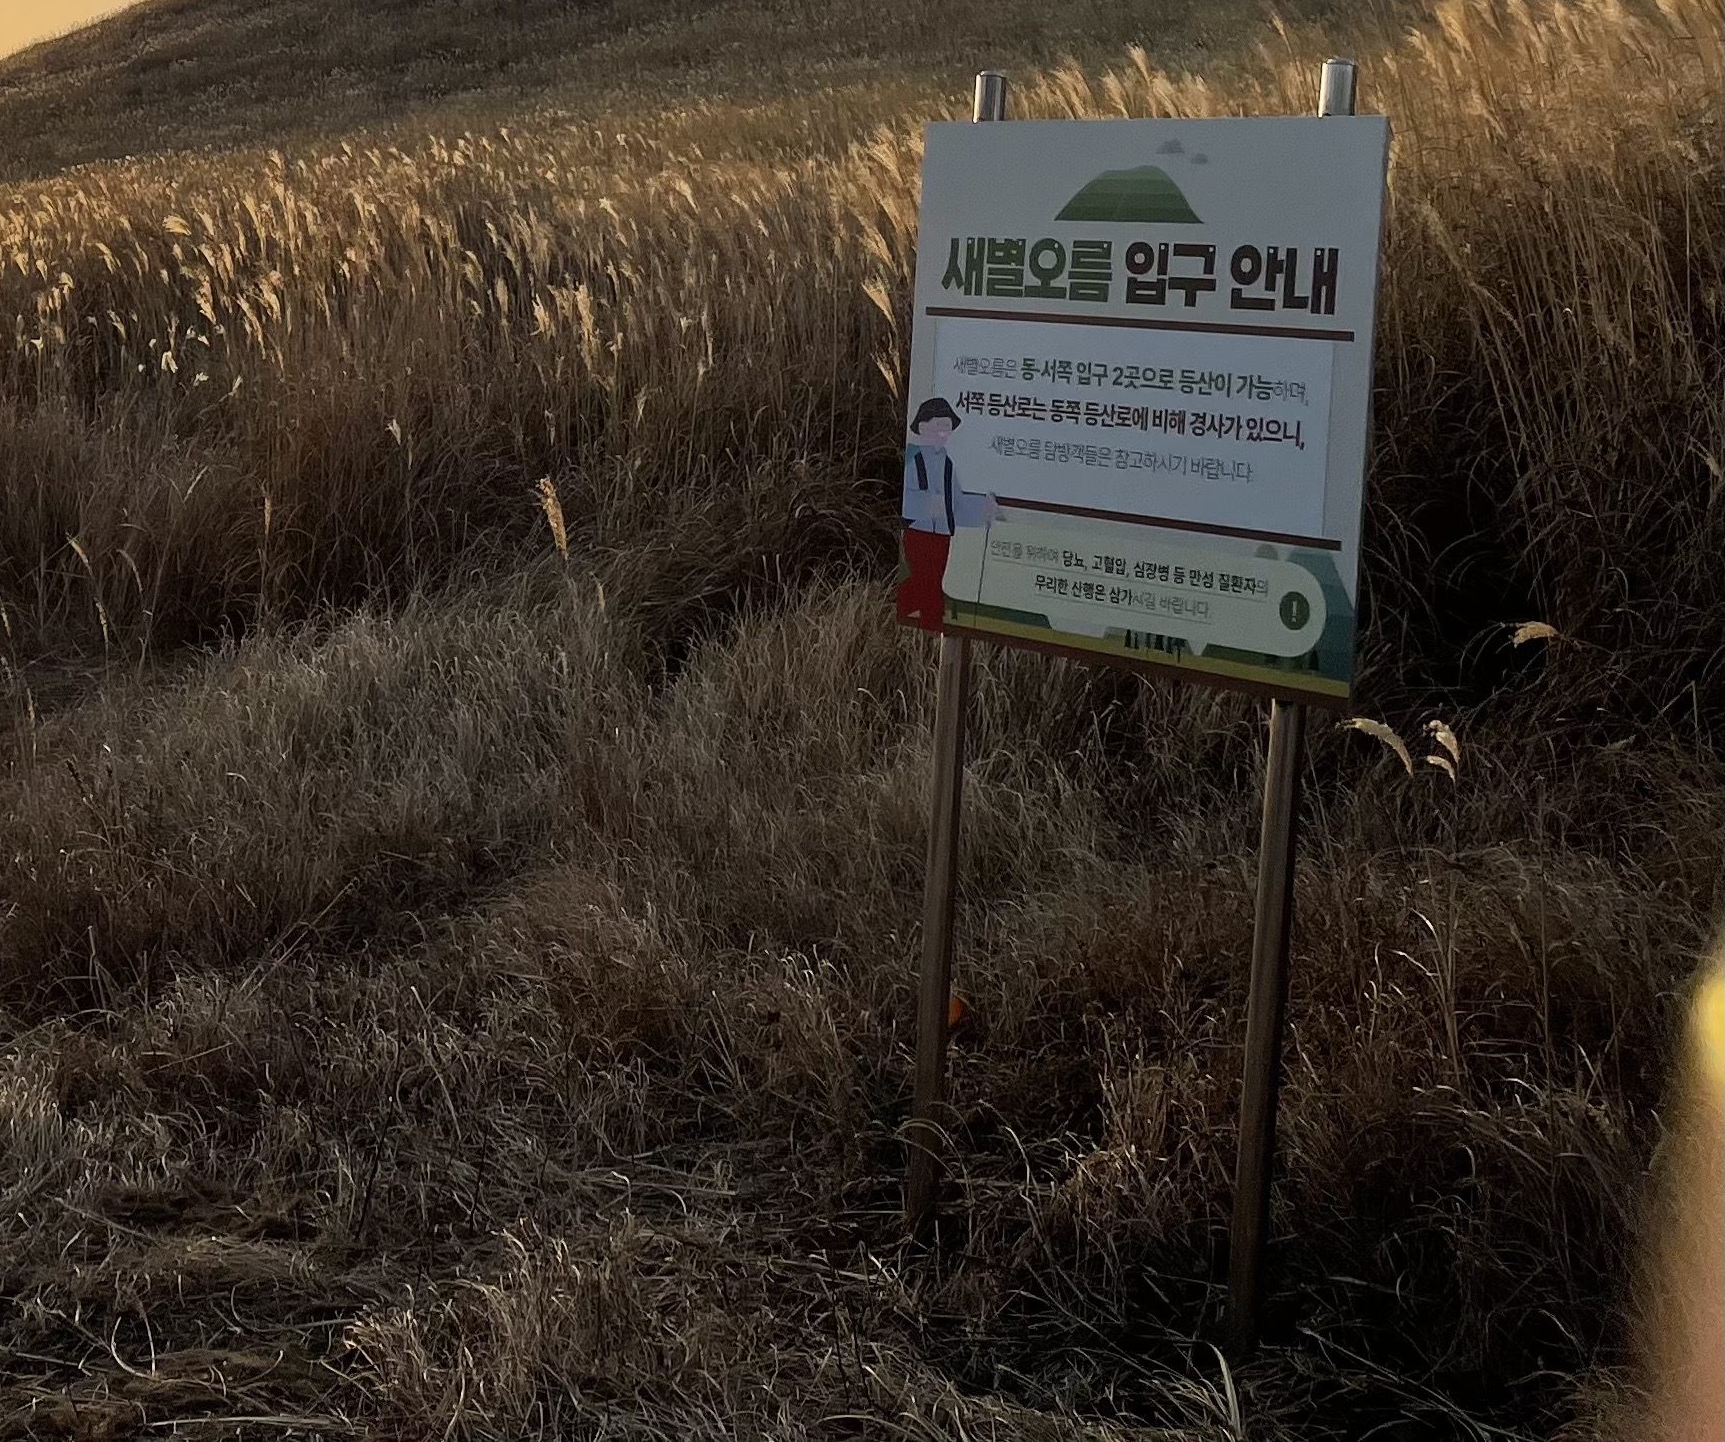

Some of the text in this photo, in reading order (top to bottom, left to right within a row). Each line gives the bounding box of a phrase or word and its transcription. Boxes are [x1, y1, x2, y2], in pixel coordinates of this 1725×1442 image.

[941, 237, 1339, 315] 새별오름 입구 안내
[953, 356, 1018, 379] 새별오름은
[1076, 362, 1109, 386] 입구
[1112, 366, 1174, 390] 2곳으로
[1179, 370, 1232, 398] 등산이
[1236, 374, 1309, 406] 가능하며,
[955, 391, 1305, 450] 서쪽 등산로는 동쪽 등산로에 비해 경사가 있으니,
[990, 436, 1041, 460] 새별오름
[1044, 440, 1112, 467] 탐방객들은
[1114, 448, 1187, 476] 참고하시기
[1035, 574, 1068, 596] 무리한
[1071, 580, 1105, 602] 산행은
[1062, 550, 1088, 572] 당뇨,
[1091, 555, 1130, 578] 고혈압,
[1133, 560, 1169, 582] 심장병
[1172, 566, 1186, 585] 등
[1189, 568, 1215, 589] 만성
[1218, 572, 1269, 596] 질환자의
